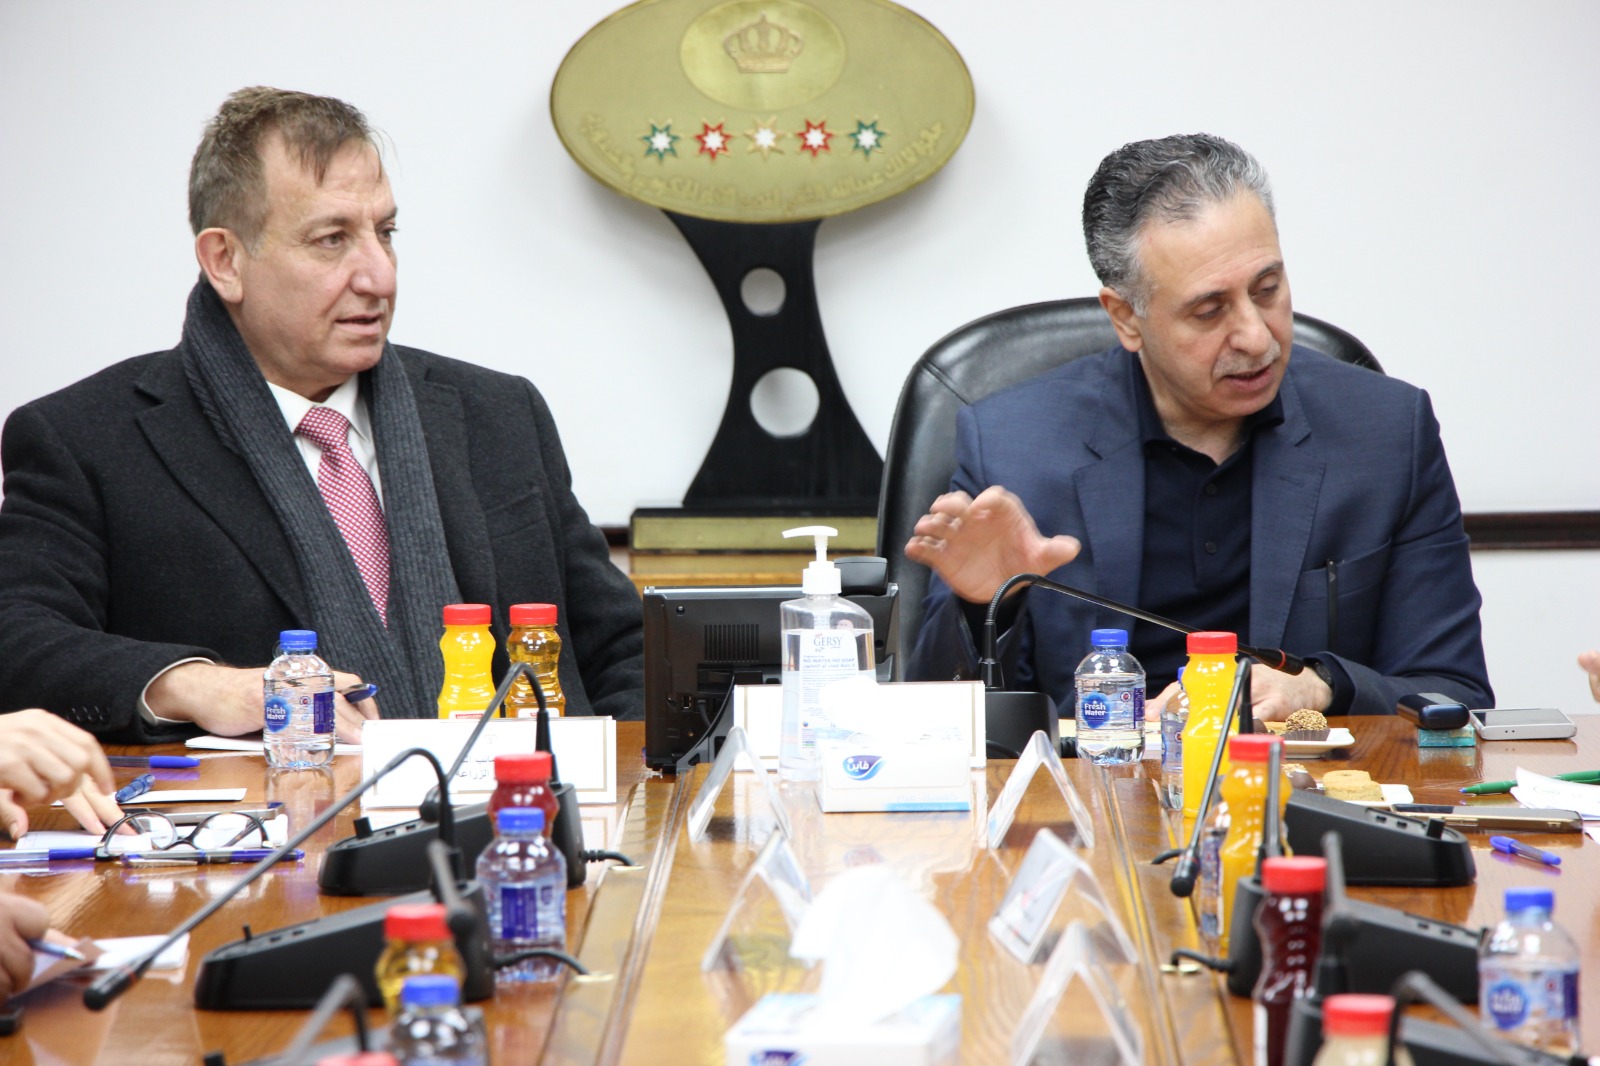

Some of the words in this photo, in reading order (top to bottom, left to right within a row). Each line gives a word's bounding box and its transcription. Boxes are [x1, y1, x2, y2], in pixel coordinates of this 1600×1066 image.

[813, 636, 842, 647] GERSY
[266, 705, 286, 715] Fresh
[1084, 702, 1106, 711] Fresh
[847, 758, 870, 773] فاين
